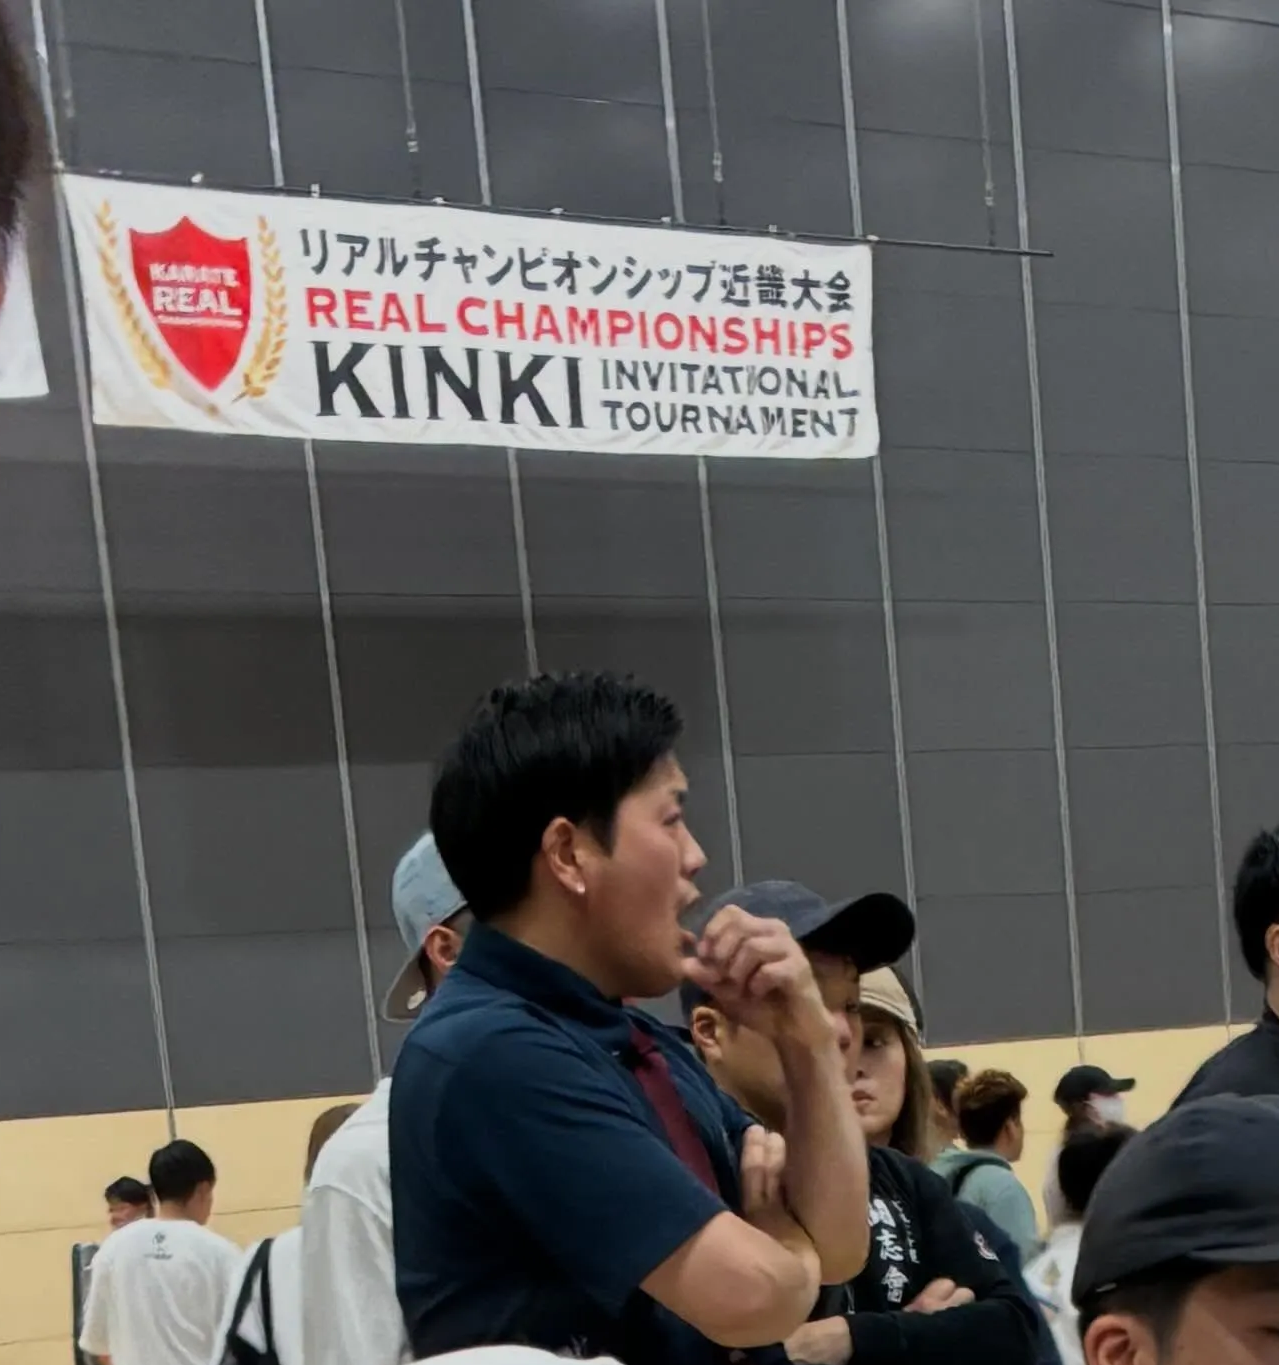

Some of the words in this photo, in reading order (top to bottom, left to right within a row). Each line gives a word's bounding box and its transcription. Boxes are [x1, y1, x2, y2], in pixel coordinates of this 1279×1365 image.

[152, 286, 242, 316] REAL
[304, 287, 448, 334] REAL
[456, 296, 855, 360] CHAMPIONSHIPS
[310, 340, 590, 431] KINKI
[601, 357, 860, 401] INVITATIONAL
[601, 400, 859, 440] TOURNAMENT
